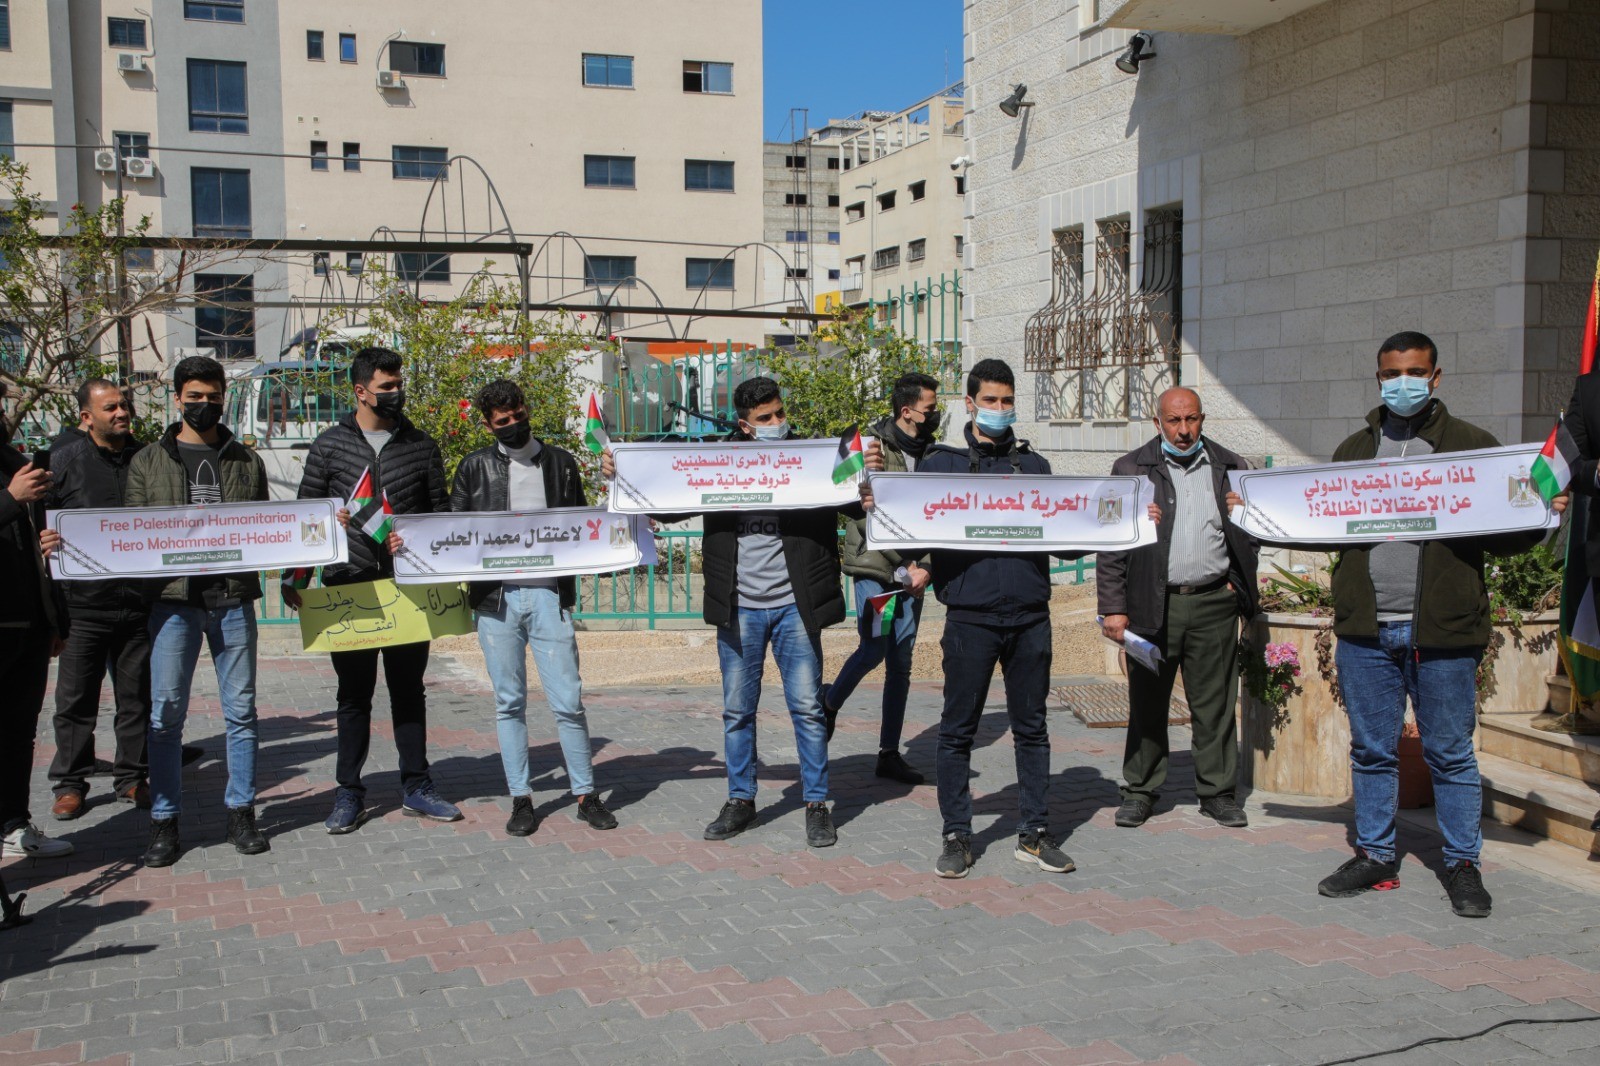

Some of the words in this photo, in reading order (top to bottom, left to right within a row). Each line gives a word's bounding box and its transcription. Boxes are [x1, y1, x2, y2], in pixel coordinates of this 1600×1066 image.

[672, 455, 734, 471] الفلسطينيين
[736, 452, 771, 469] الأسرى
[773, 452, 802, 470] يعيش
[686, 474, 714, 490] صعبة
[758, 473, 790, 488] ظروف
[1401, 469, 1442, 491] سكوت
[1447, 465, 1475, 484] لماذا
[1304, 476, 1348, 502] الدولي
[1351, 473, 1398, 498] المجتمع
[923, 491, 978, 520] الحلبي
[983, 491, 1025, 511] لمحمد
[1030, 489, 1088, 518] الحرية
[1449, 495, 1472, 514] عن
[100, 519, 130, 532] Free
[133, 517, 204, 530] Palestinian
[208, 512, 296, 526] Humanitarian
[586, 518, 602, 540] لا
[1354, 523, 1371, 533] العالي
[1373, 521, 1395, 530] والتعليم
[1397, 520, 1416, 529] التربية
[1417, 520, 1432, 528] وزارة
[483, 532, 521, 545] محمد
[971, 528, 987, 536] العالي
[987, 528, 1008, 536] والتعليم
[1010, 528, 1026, 536] التربية
[1027, 528, 1040, 536] وزارة
[111, 539, 144, 552] Hero
[147, 534, 226, 550] Mohammed
[229, 530, 292, 545] El-Halabi!
[430, 530, 479, 555] الحلبي
[169, 555, 185, 564] العالي
[208, 551, 225, 560] التربية
[225, 551, 239, 559] وزارة
